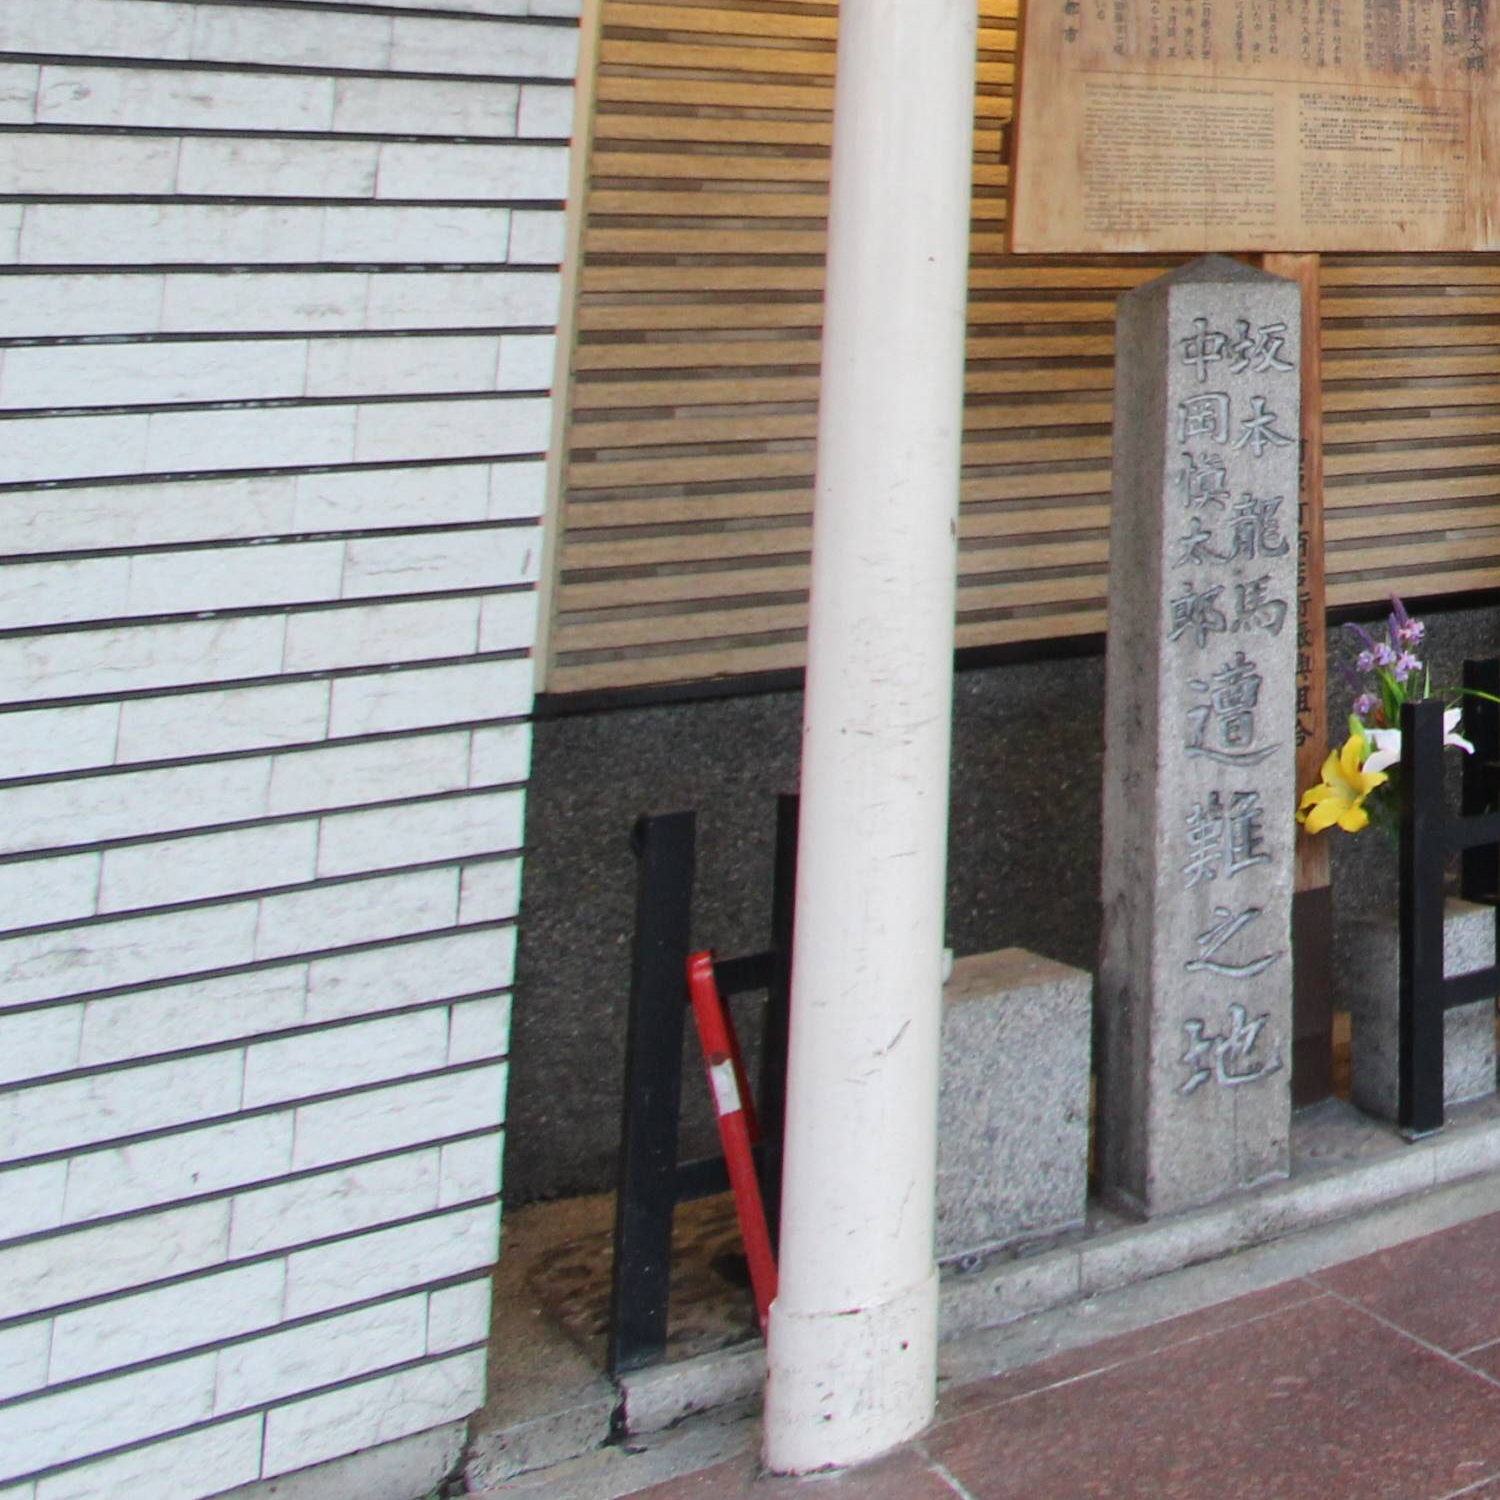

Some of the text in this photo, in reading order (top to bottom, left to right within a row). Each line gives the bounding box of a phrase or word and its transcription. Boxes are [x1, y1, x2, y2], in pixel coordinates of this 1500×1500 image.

[1226, 317, 1298, 638] 坂本龍馬
[1176, 650, 1285, 1098] 遭難之地
